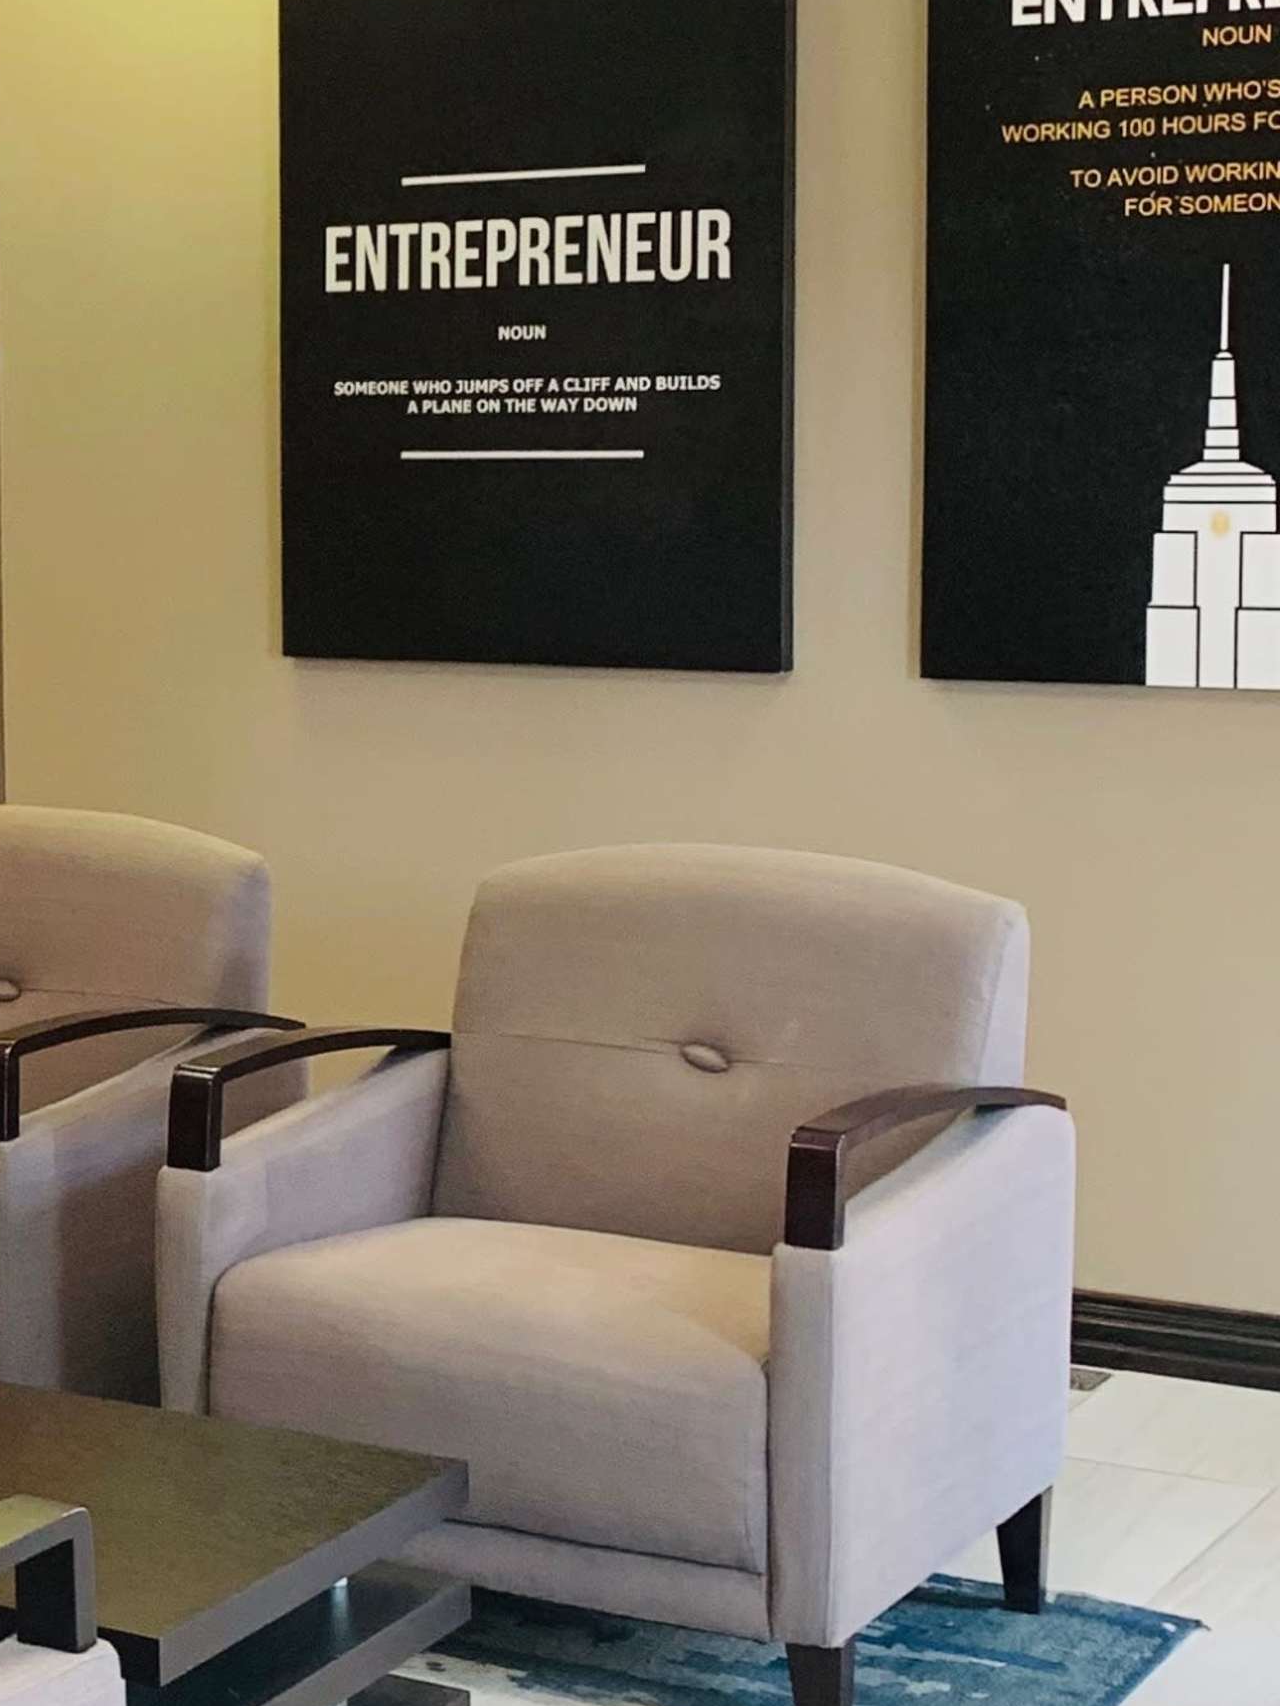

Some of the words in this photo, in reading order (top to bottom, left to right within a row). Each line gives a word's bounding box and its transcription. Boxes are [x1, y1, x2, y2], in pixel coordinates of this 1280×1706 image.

[1202, 24, 1272, 48] NOUN
[1078, 90, 1095, 110] A
[1100, 83, 1197, 108] PERSON
[1203, 78, 1280, 102] WHO'S
[1001, 119, 1111, 143] WORKING
[1119, 117, 1156, 139] 100
[1161, 112, 1247, 136] HOURS
[1069, 168, 1102, 188] TO
[1106, 164, 1180, 187] AVOID
[1124, 194, 1173, 217] FOR
[324, 208, 732, 294] ENTREPRENEUR
[497, 324, 547, 341] NOUN
[333, 380, 409, 396] SOMEONE
[413, 379, 452, 395] WHO
[454, 378, 509, 395] JUMPS
[513, 378, 545, 394] OFF
[547, 378, 560, 393] A
[563, 377, 611, 393] CLIFF
[615, 376, 651, 392] AND
[655, 374, 721, 392] BUILDS
[407, 400, 419, 414] A
[422, 399, 472, 414] PLANE
[476, 398, 501, 414] ON
[504, 398, 537, 413] THE
[541, 398, 580, 412] WAY
[583, 397, 637, 413] DOWN
